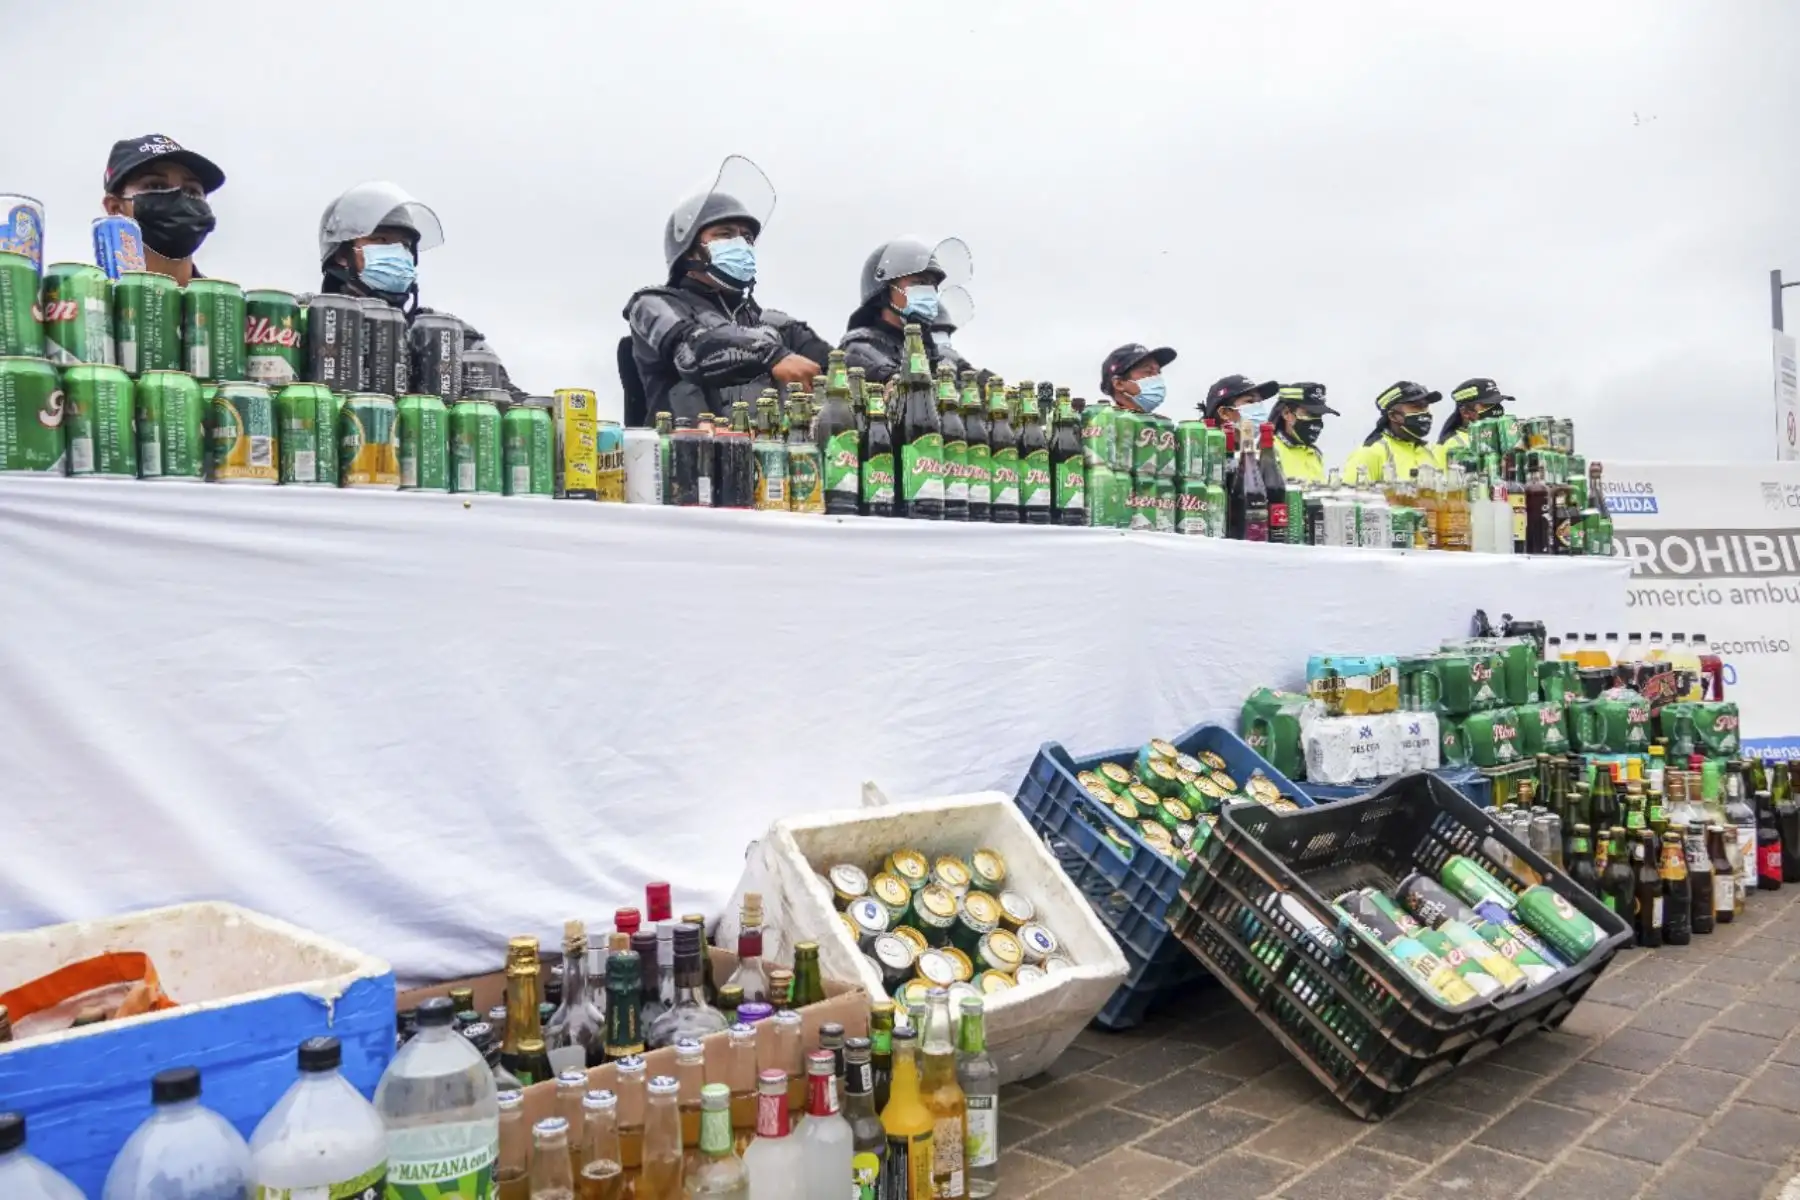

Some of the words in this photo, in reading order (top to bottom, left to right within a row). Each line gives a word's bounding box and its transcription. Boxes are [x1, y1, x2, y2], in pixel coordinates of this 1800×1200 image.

[244, 315, 301, 348] ilsen
[324, 357, 336, 380] TRES
[1600, 482, 1654, 495] RRILLOS
[1605, 497, 1654, 512] CUIDA
[1612, 535, 1800, 575] ROHIBI
[1626, 582, 1722, 608] omercio
[1730, 581, 1800, 607] ambu
[1710, 636, 1790, 655] ecomiso
[1744, 745, 1800, 761] Ordena
[399, 1156, 468, 1180] MANZANA
[470, 1151, 487, 1168] con
